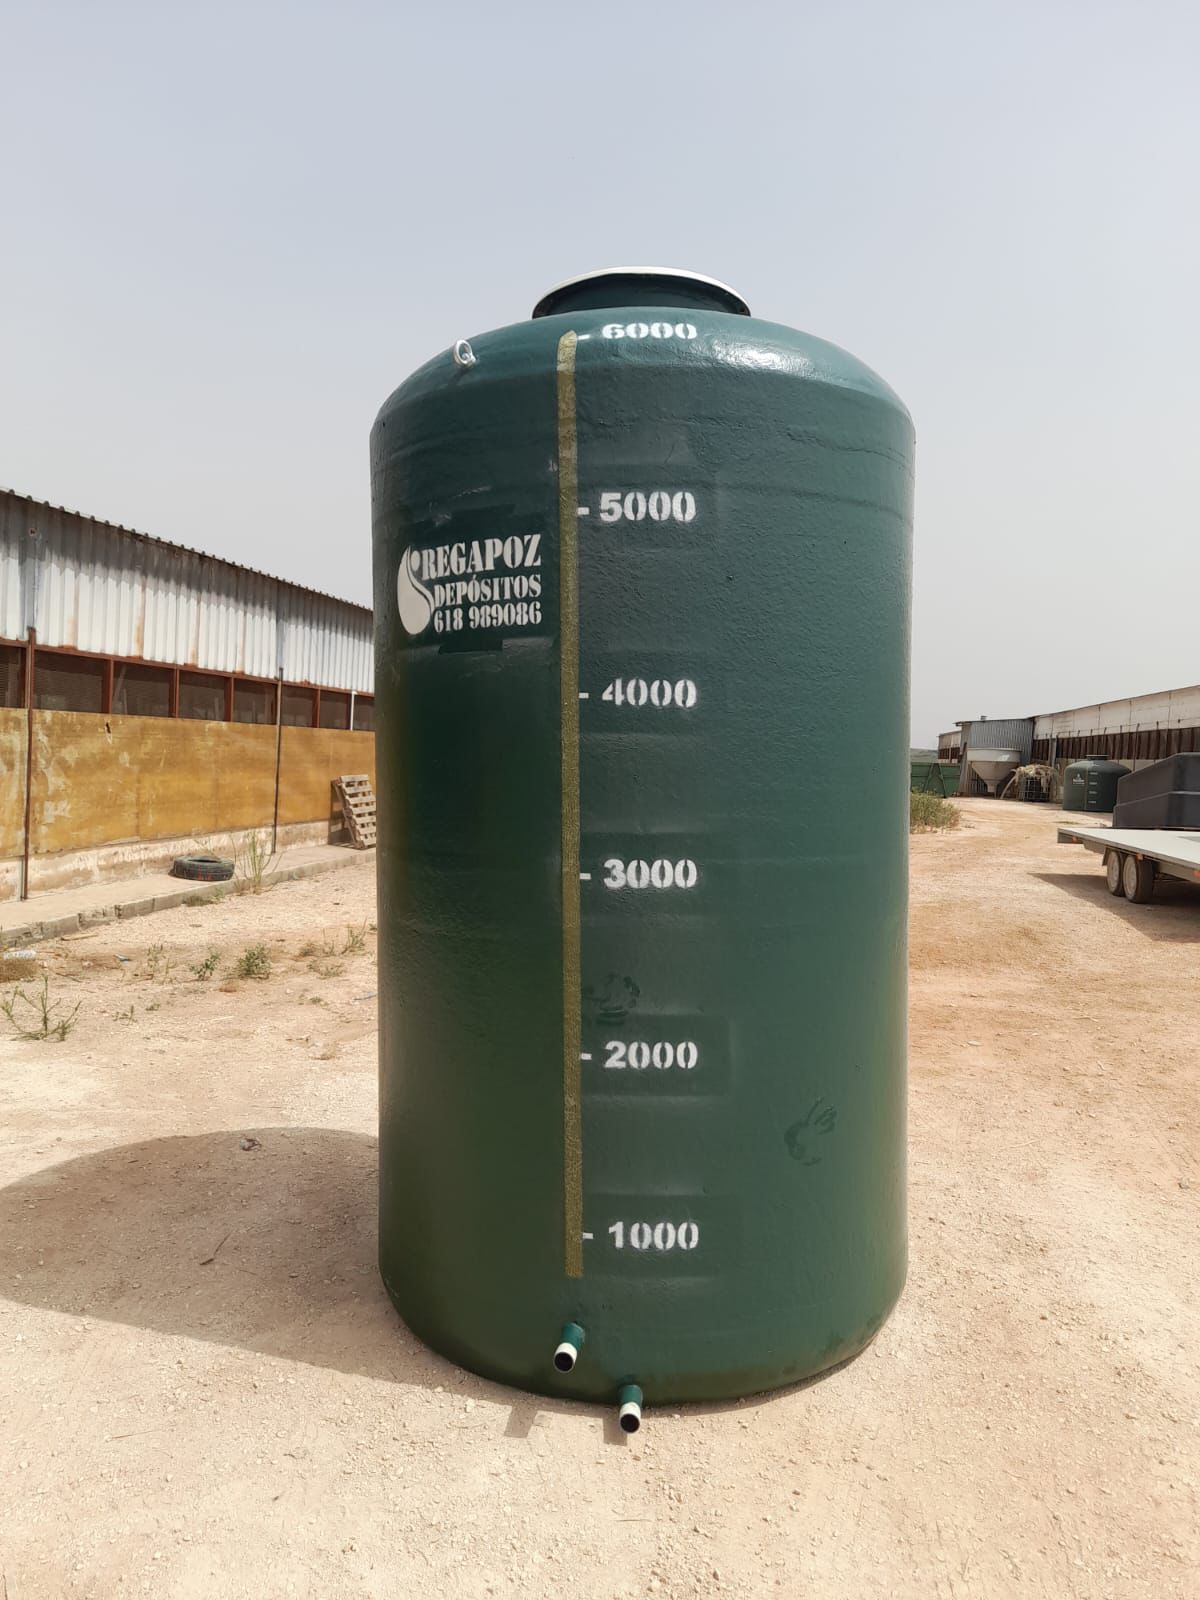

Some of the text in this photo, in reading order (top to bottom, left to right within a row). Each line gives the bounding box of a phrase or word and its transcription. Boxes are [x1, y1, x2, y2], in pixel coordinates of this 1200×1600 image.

[601, 322, 698, 339] 6000
[598, 490, 697, 523] 5000
[421, 533, 542, 581] REGAPOZ
[434, 574, 542, 608] DEPÓSITOS
[433, 601, 542, 633] 618 989086
[601, 678, 698, 708] 4000
[603, 858, 699, 890] 3000
[603, 1040, 699, 1071] 2000
[607, 1221, 699, 1251] 1000
